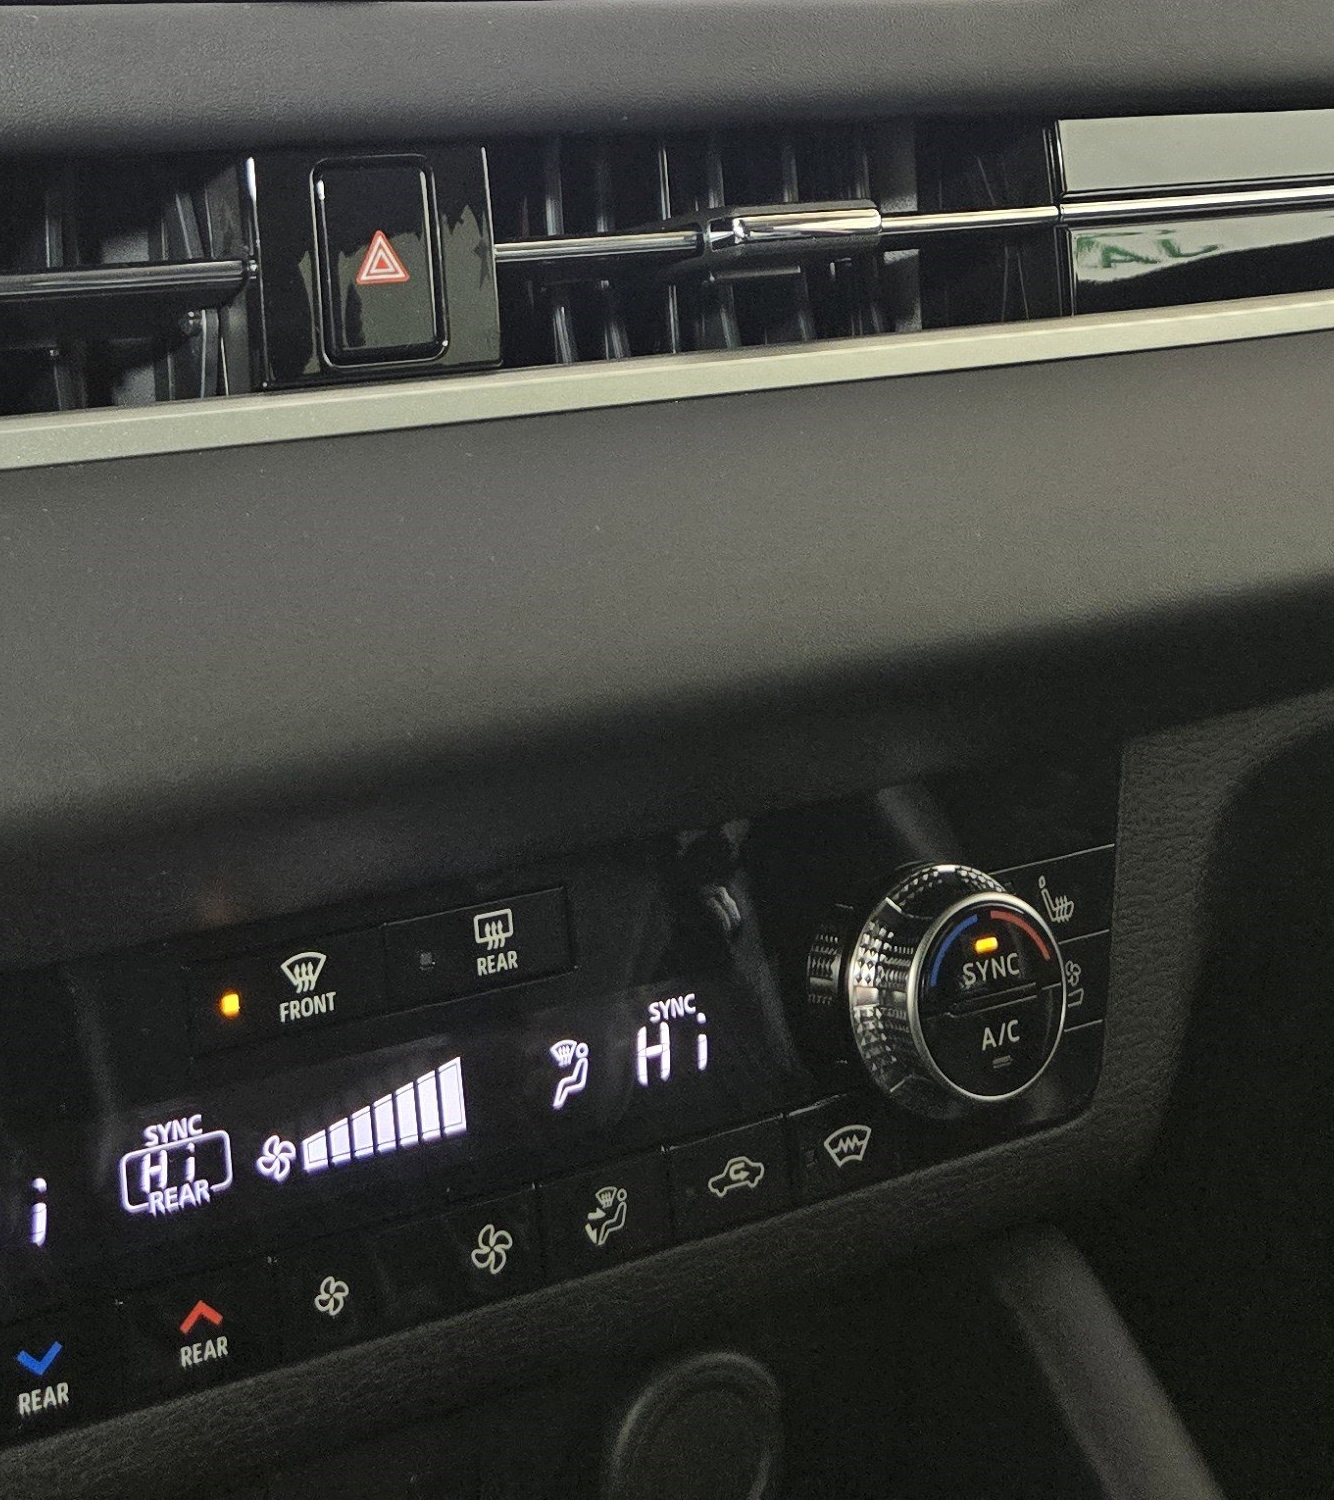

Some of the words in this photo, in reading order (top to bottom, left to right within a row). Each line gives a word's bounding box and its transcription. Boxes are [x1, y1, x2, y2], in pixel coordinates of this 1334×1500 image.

[476, 950, 519, 977] REAR
[962, 951, 1020, 987] SYNC
[279, 991, 337, 1023] FRONT
[648, 993, 697, 1023] SYNC
[981, 1019, 1020, 1051] A/C
[143, 1113, 204, 1147] SYNC
[147, 1178, 211, 1218] REAR
[179, 1336, 229, 1368] REAR
[17, 1382, 70, 1416] REAR
